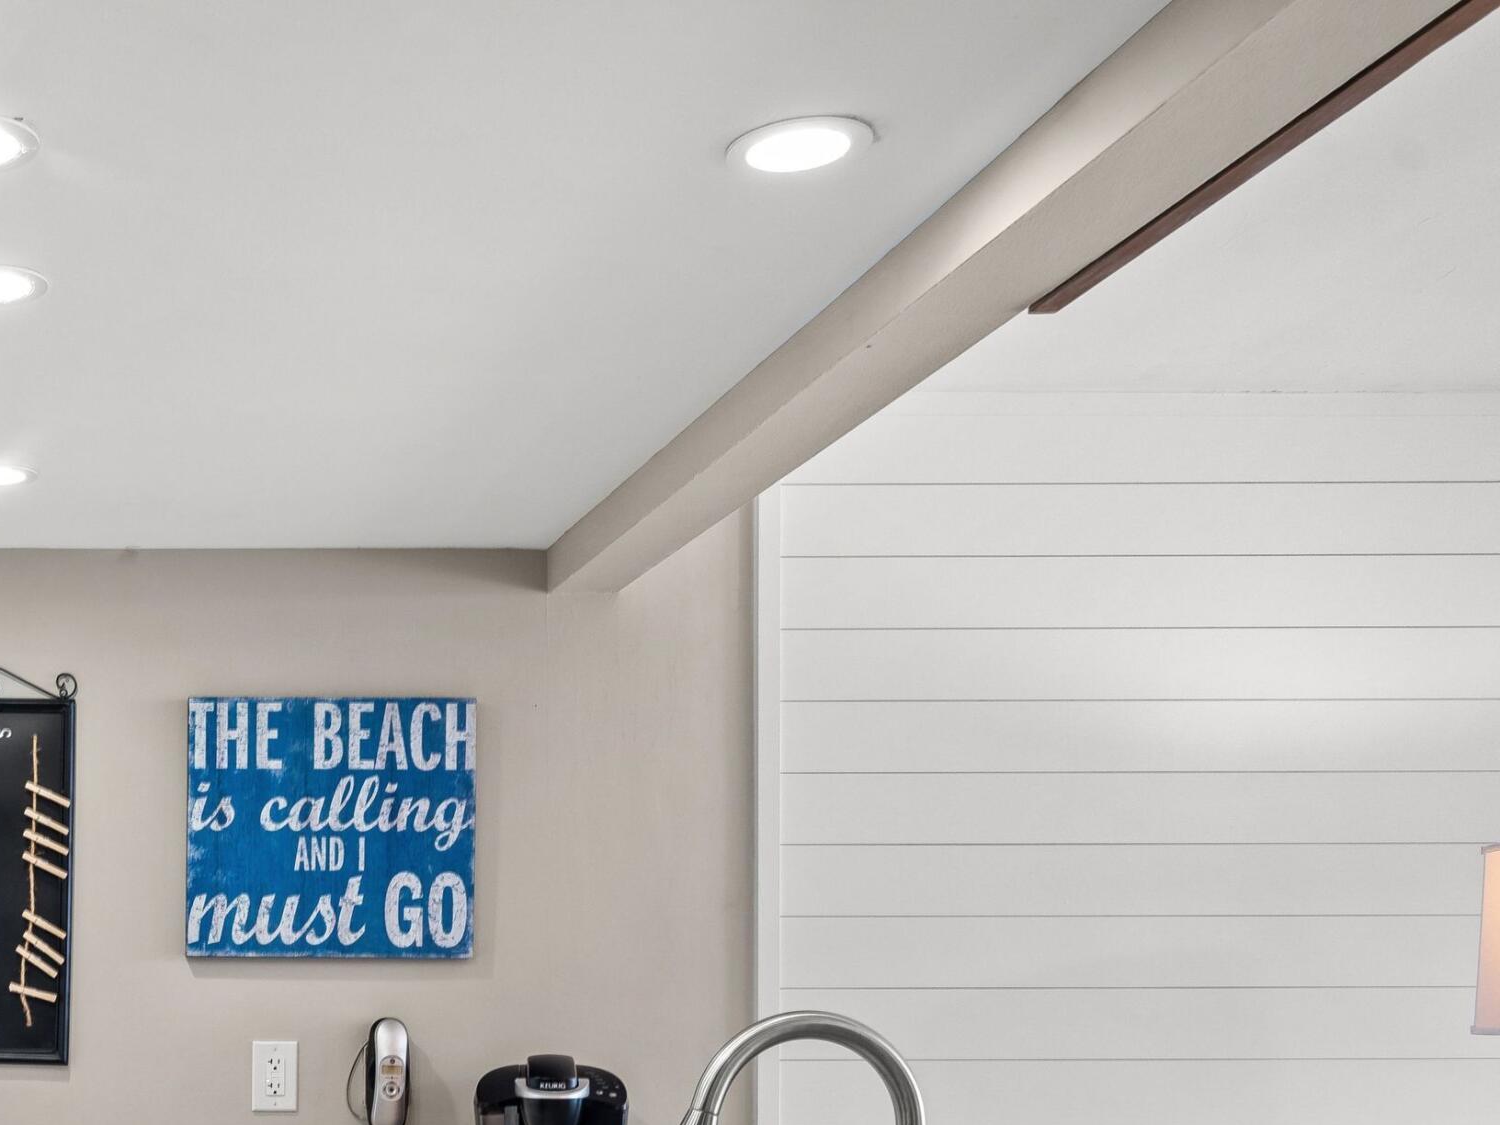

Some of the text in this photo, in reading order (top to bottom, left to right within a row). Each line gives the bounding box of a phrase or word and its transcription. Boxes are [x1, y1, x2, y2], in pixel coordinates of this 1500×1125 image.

[189, 702, 476, 771] THE BEACH
[190, 774, 473, 851] is calling
[294, 836, 366, 872] AND I
[187, 871, 468, 949] must GO
[539, 1081, 567, 1090] KEURIG
